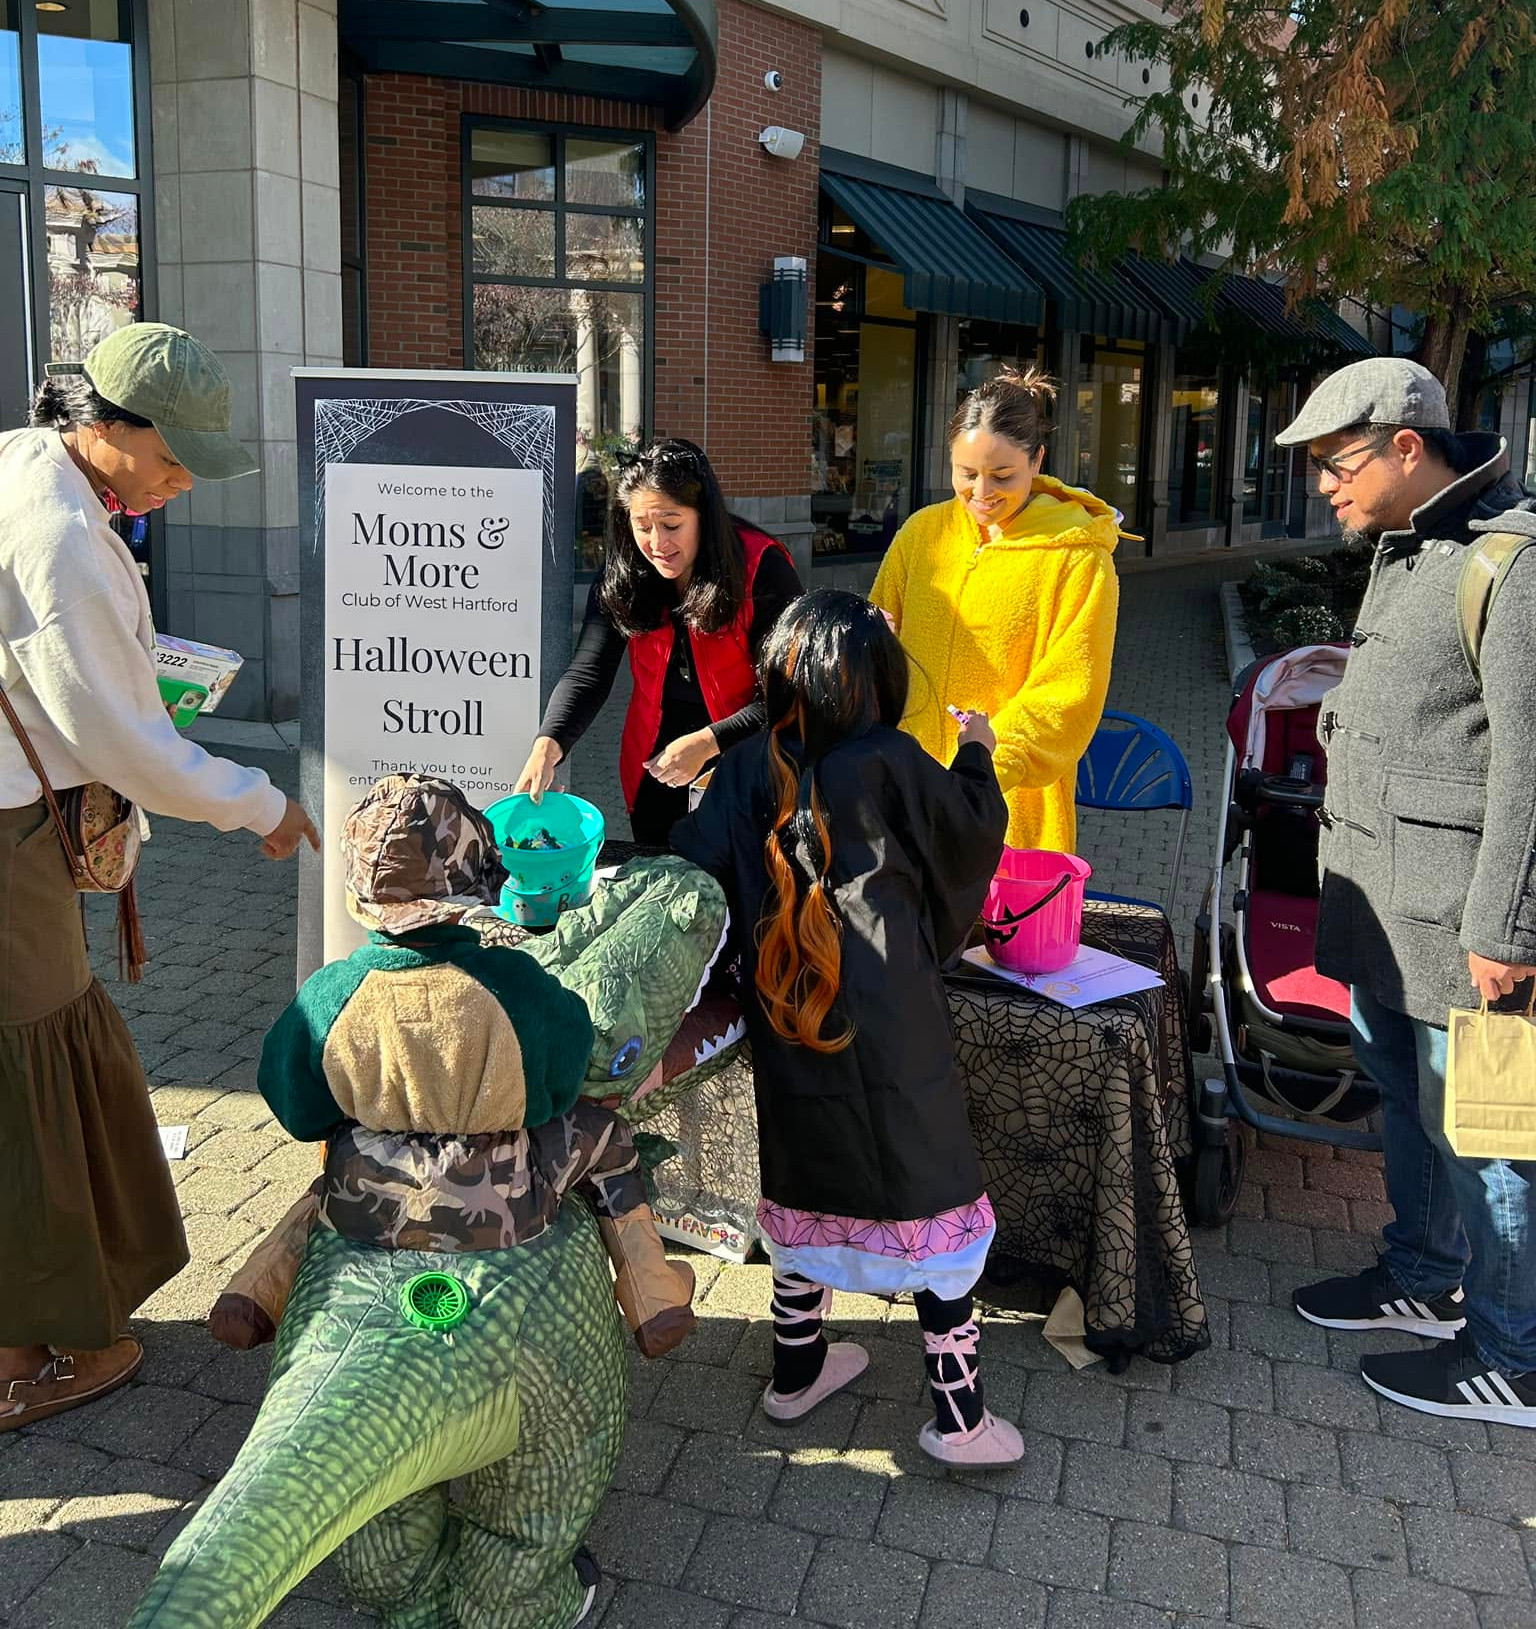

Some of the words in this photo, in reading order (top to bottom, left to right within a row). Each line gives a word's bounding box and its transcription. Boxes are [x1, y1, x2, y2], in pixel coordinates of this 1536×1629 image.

[377, 482, 447, 497] Welcome
[451, 486, 467, 498] to
[470, 485, 495, 499] the
[352, 512, 466, 549] Moms
[477, 516, 510, 551] &
[383, 553, 480, 590] More
[341, 592, 381, 608] Club
[384, 593, 402, 609] of
[405, 594, 448, 610] West
[452, 596, 519, 613] Hartford
[333, 636, 534, 679] Halloween
[383, 699, 485, 737] Stroll
[371, 759, 417, 773] Thank
[420, 763, 447, 775] you
[451, 763, 466, 775] to
[469, 766, 493, 776] our
[1271, 922, 1301, 932] VISTA
